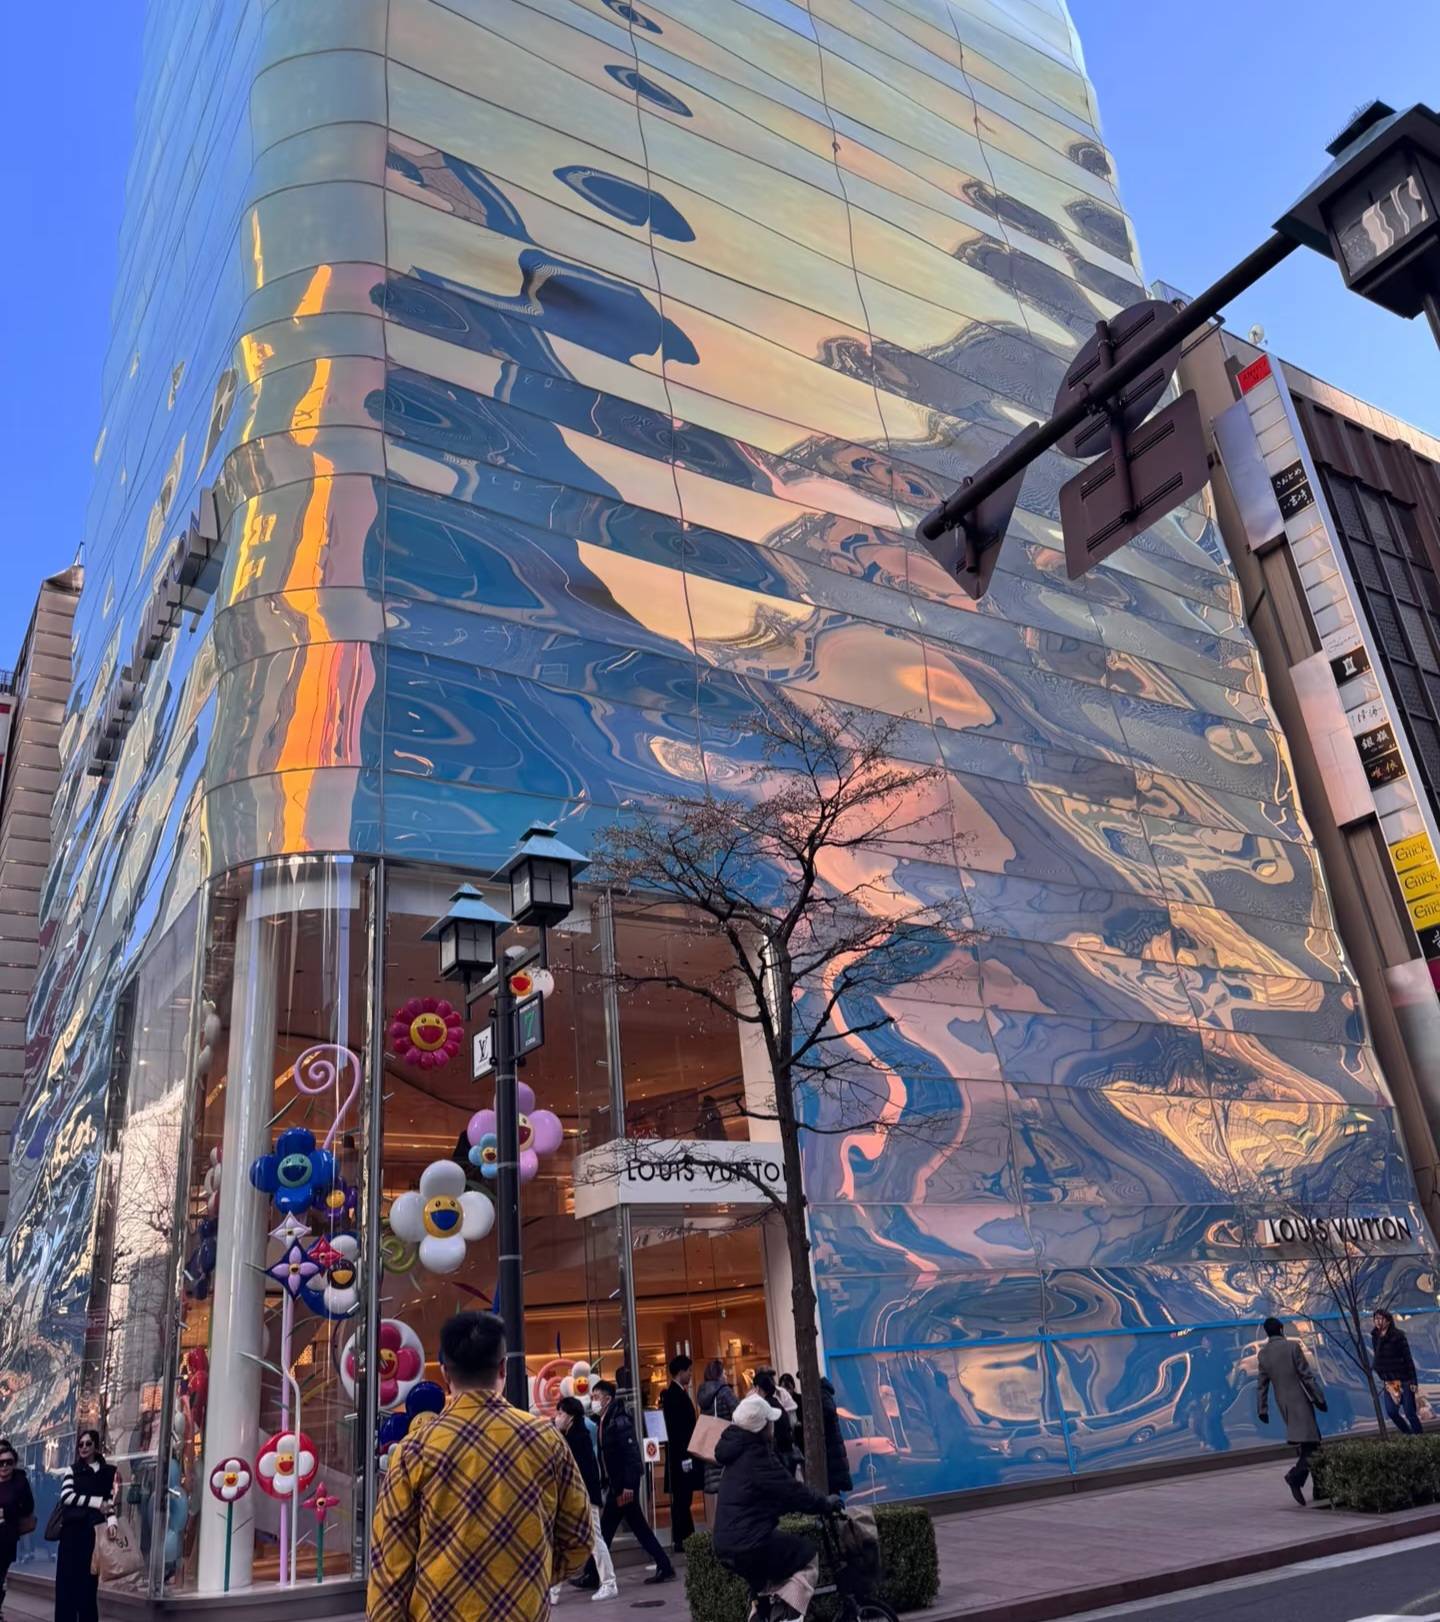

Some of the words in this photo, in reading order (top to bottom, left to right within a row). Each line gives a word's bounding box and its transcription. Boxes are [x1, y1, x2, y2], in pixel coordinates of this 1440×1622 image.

[1413, 903, 1440, 920] CHIC
[627, 1160, 694, 1182] LOUIS
[704, 1160, 787, 1182] VUITTO
[1269, 1218, 1329, 1243] LOUIS
[1331, 1216, 1412, 1241] VUITTON
